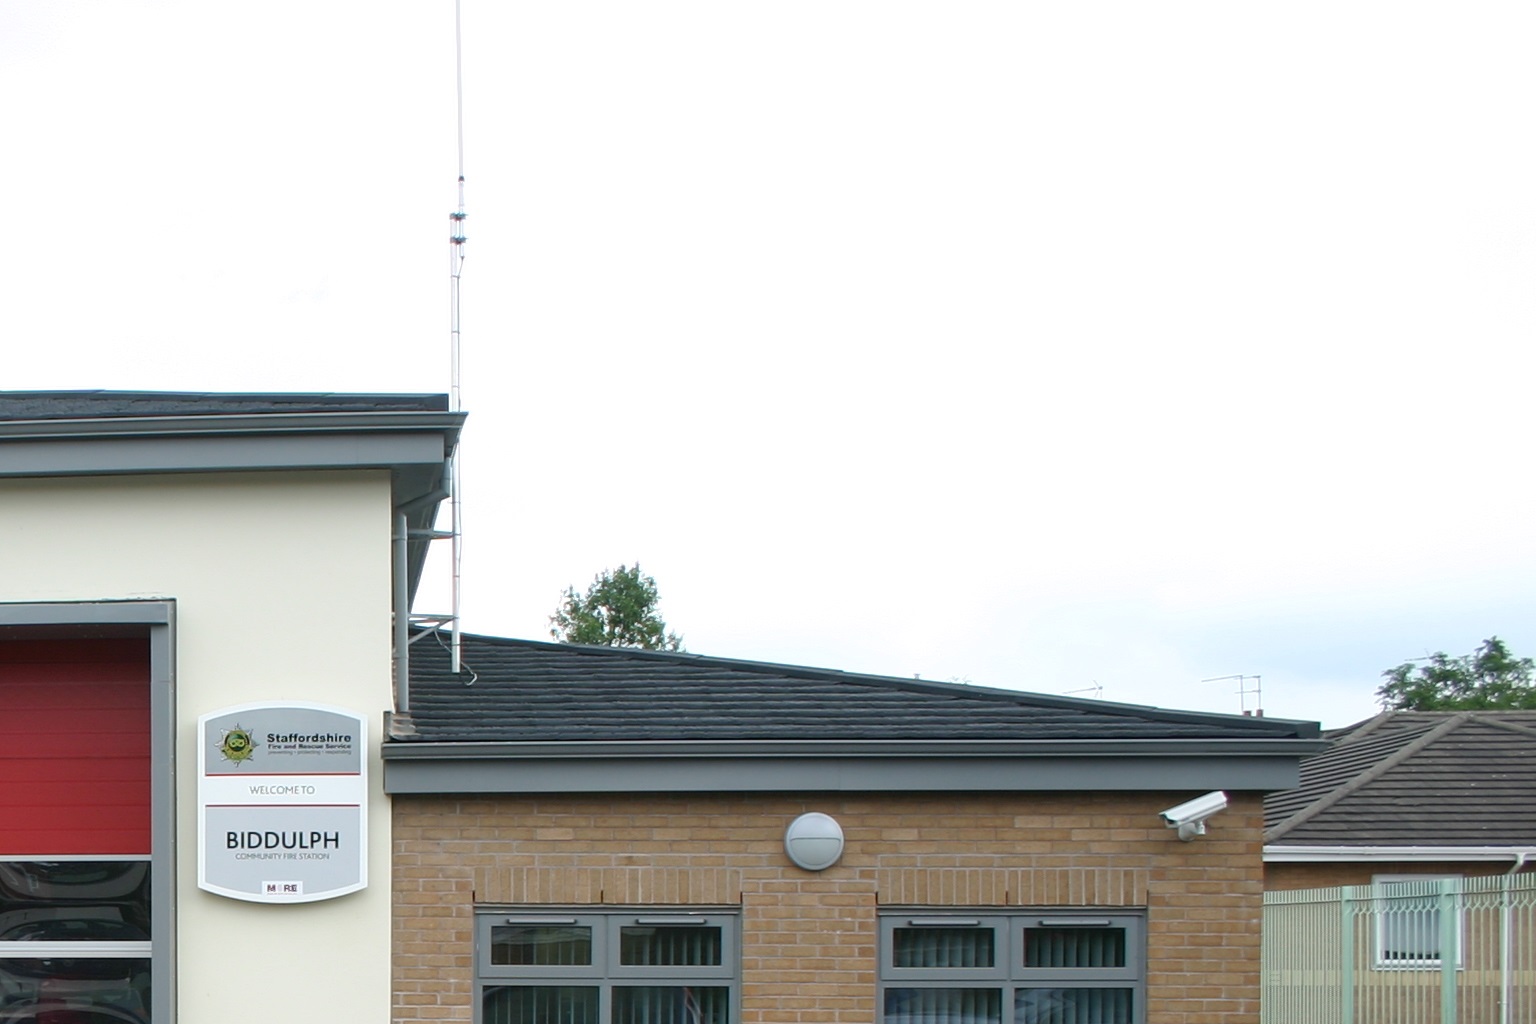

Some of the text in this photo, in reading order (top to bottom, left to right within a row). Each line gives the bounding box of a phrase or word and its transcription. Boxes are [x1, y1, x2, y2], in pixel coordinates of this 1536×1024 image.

[267, 733, 352, 743] Staffordshire
[249, 785, 316, 795] WELCOME TO
[226, 831, 339, 849] BIDDULPH
